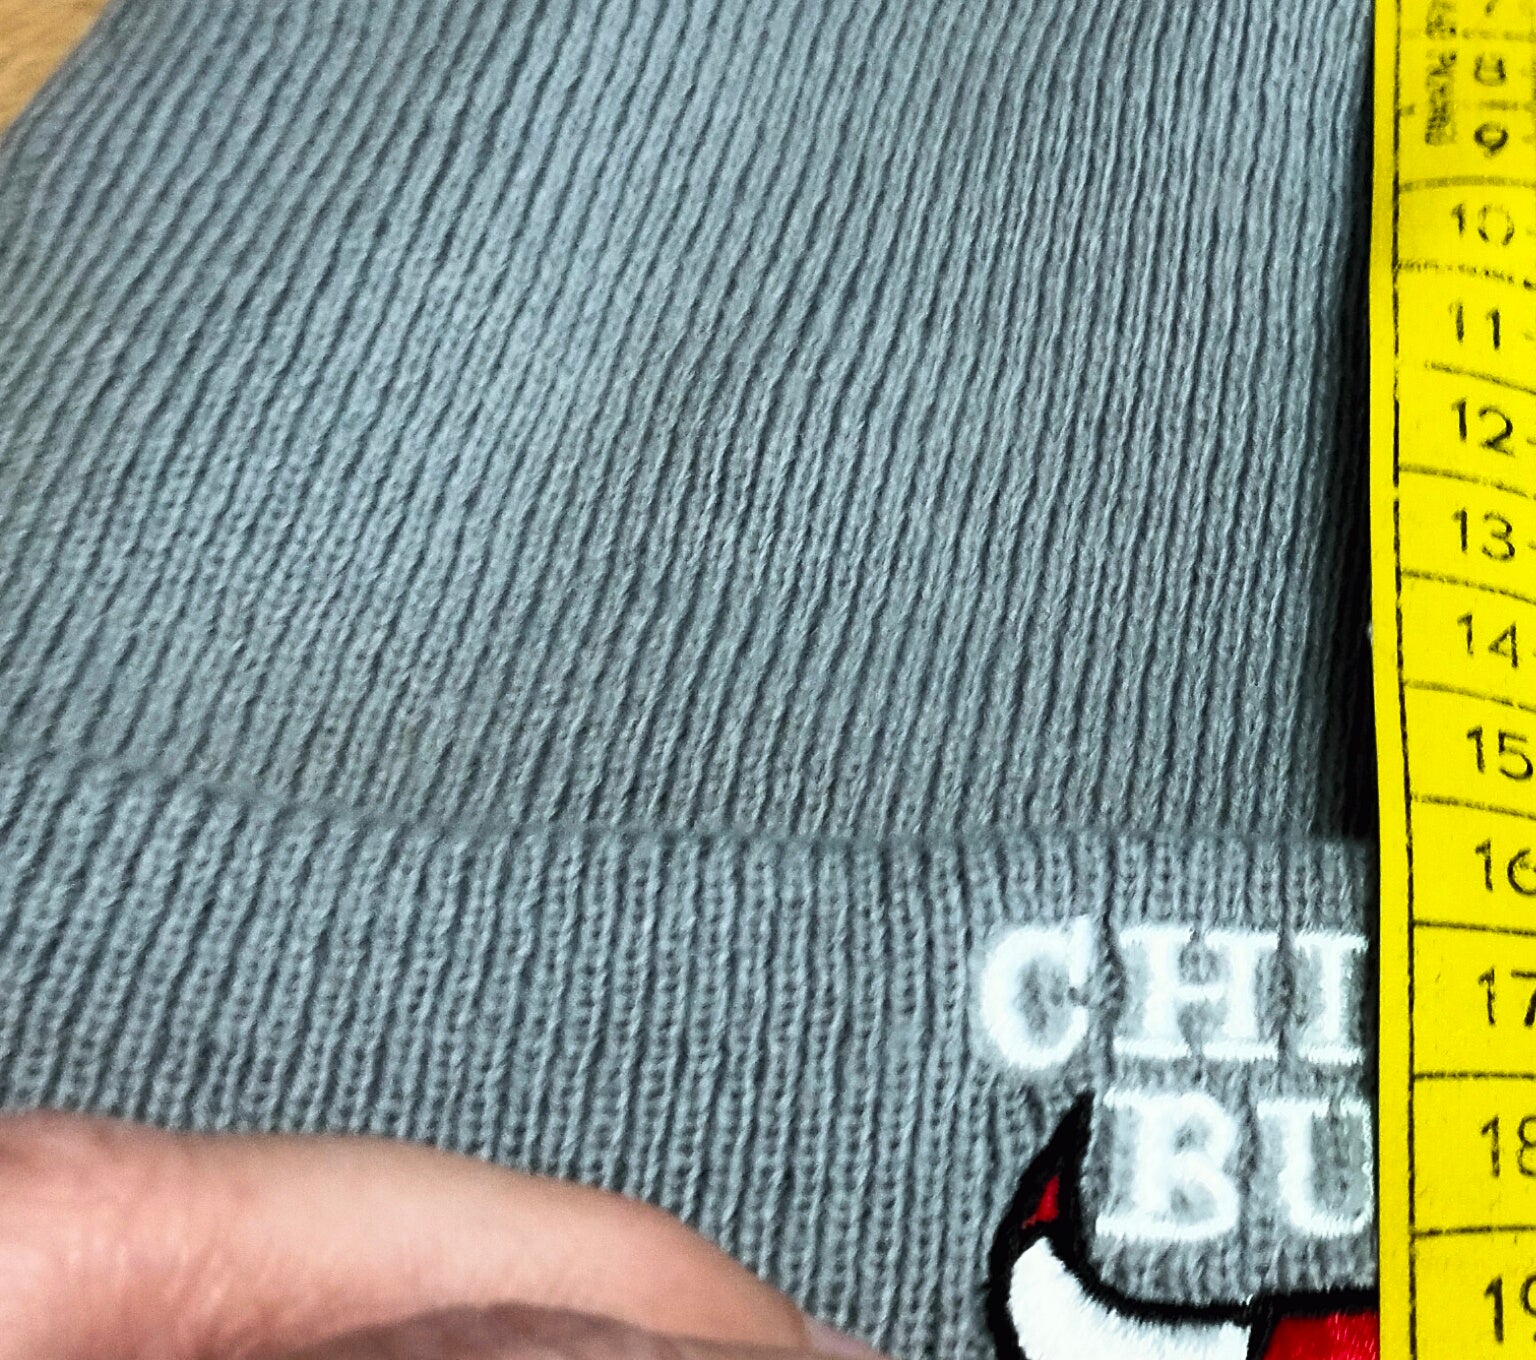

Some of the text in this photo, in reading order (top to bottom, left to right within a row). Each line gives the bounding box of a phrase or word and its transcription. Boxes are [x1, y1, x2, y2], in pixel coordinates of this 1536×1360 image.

[1473, 121, 1509, 158] 9
[1449, 202, 1516, 247] 10
[1448, 302, 1501, 352] 11
[1450, 397, 1516, 455] 12
[1451, 507, 1517, 561] 13
[1455, 613, 1519, 670] 14
[1465, 725, 1534, 781] 15
